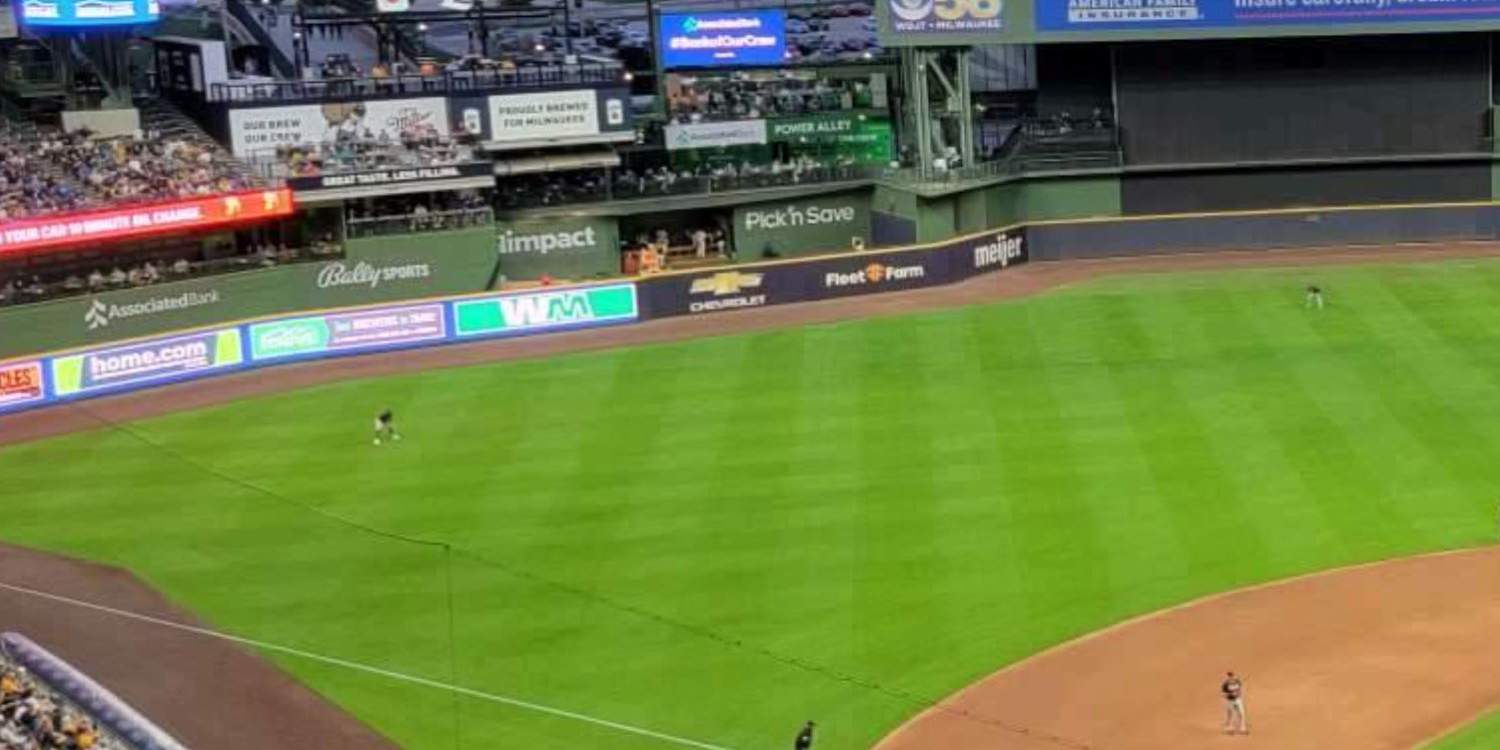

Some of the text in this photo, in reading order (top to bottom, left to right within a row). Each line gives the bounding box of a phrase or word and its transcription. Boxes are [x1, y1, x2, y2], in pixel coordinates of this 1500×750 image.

[817, 120, 852, 132] ALLEY
[805, 205, 855, 224] Save
[974, 233, 1024, 269] meijer
[318, 260, 429, 288] Bally SPORTS
[825, 265, 924, 288] Fleet Farm
[107, 289, 219, 319] AssociatedBank
[689, 294, 766, 312] CHEVROLET
[91, 341, 207, 374] home.com
